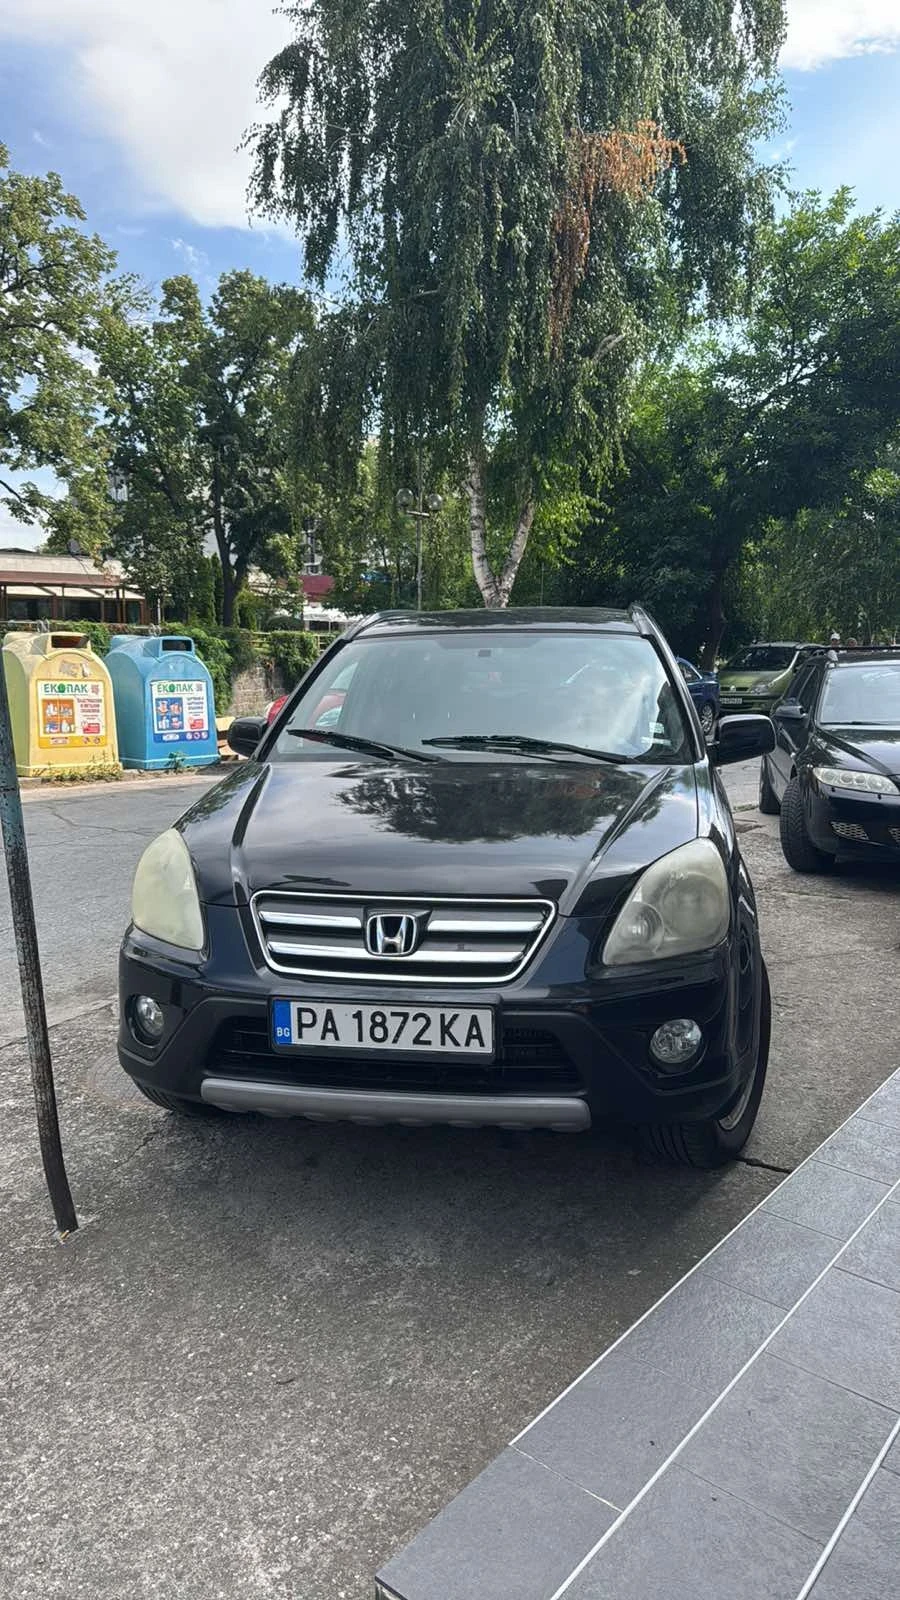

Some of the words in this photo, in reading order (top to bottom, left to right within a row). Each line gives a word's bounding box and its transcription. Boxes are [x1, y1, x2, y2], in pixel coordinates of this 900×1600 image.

[43, 683, 88, 693] ЕКОПАК
[157, 683, 194, 692] ЕКОПАК
[296, 1007, 340, 1041] PA
[352, 1009, 432, 1045] 1872
[439, 1013, 485, 1047] KA
[276, 1027, 290, 1038] BG
